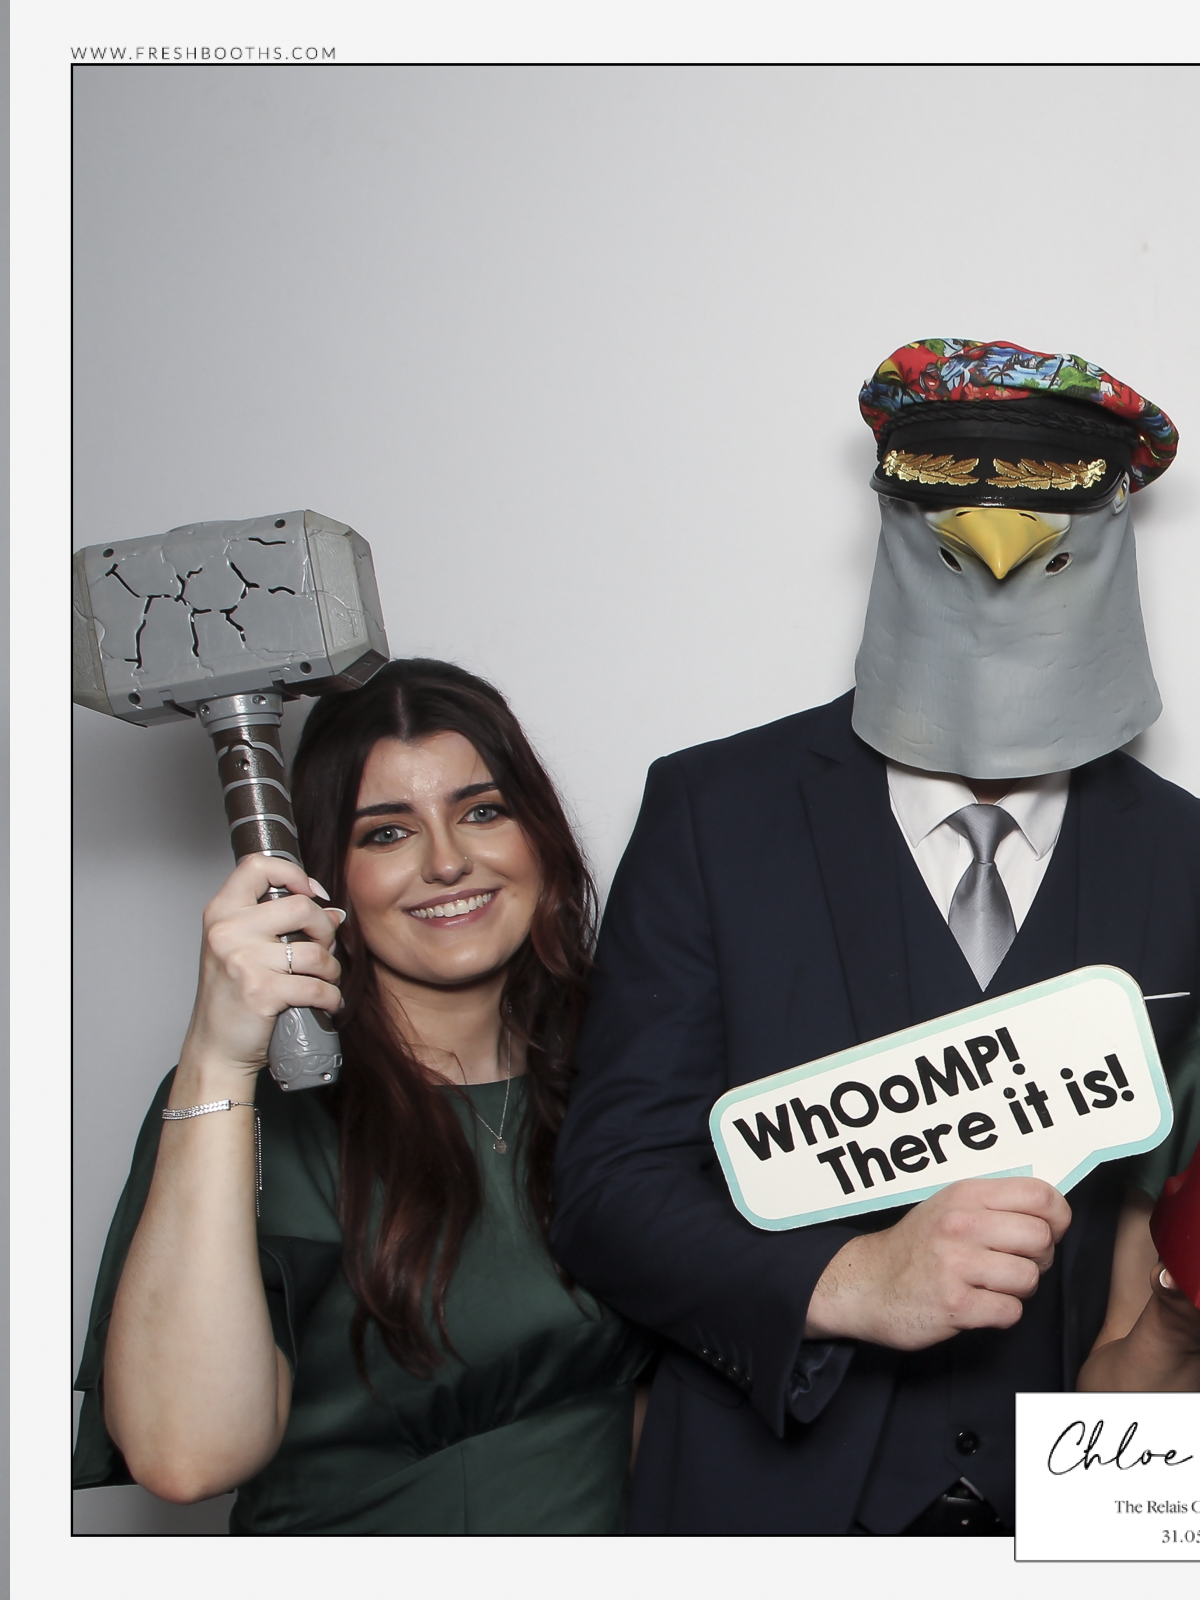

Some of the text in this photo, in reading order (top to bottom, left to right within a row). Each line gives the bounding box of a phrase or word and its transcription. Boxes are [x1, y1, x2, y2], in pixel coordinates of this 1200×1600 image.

[816, 1053, 1135, 1195] There it is!
